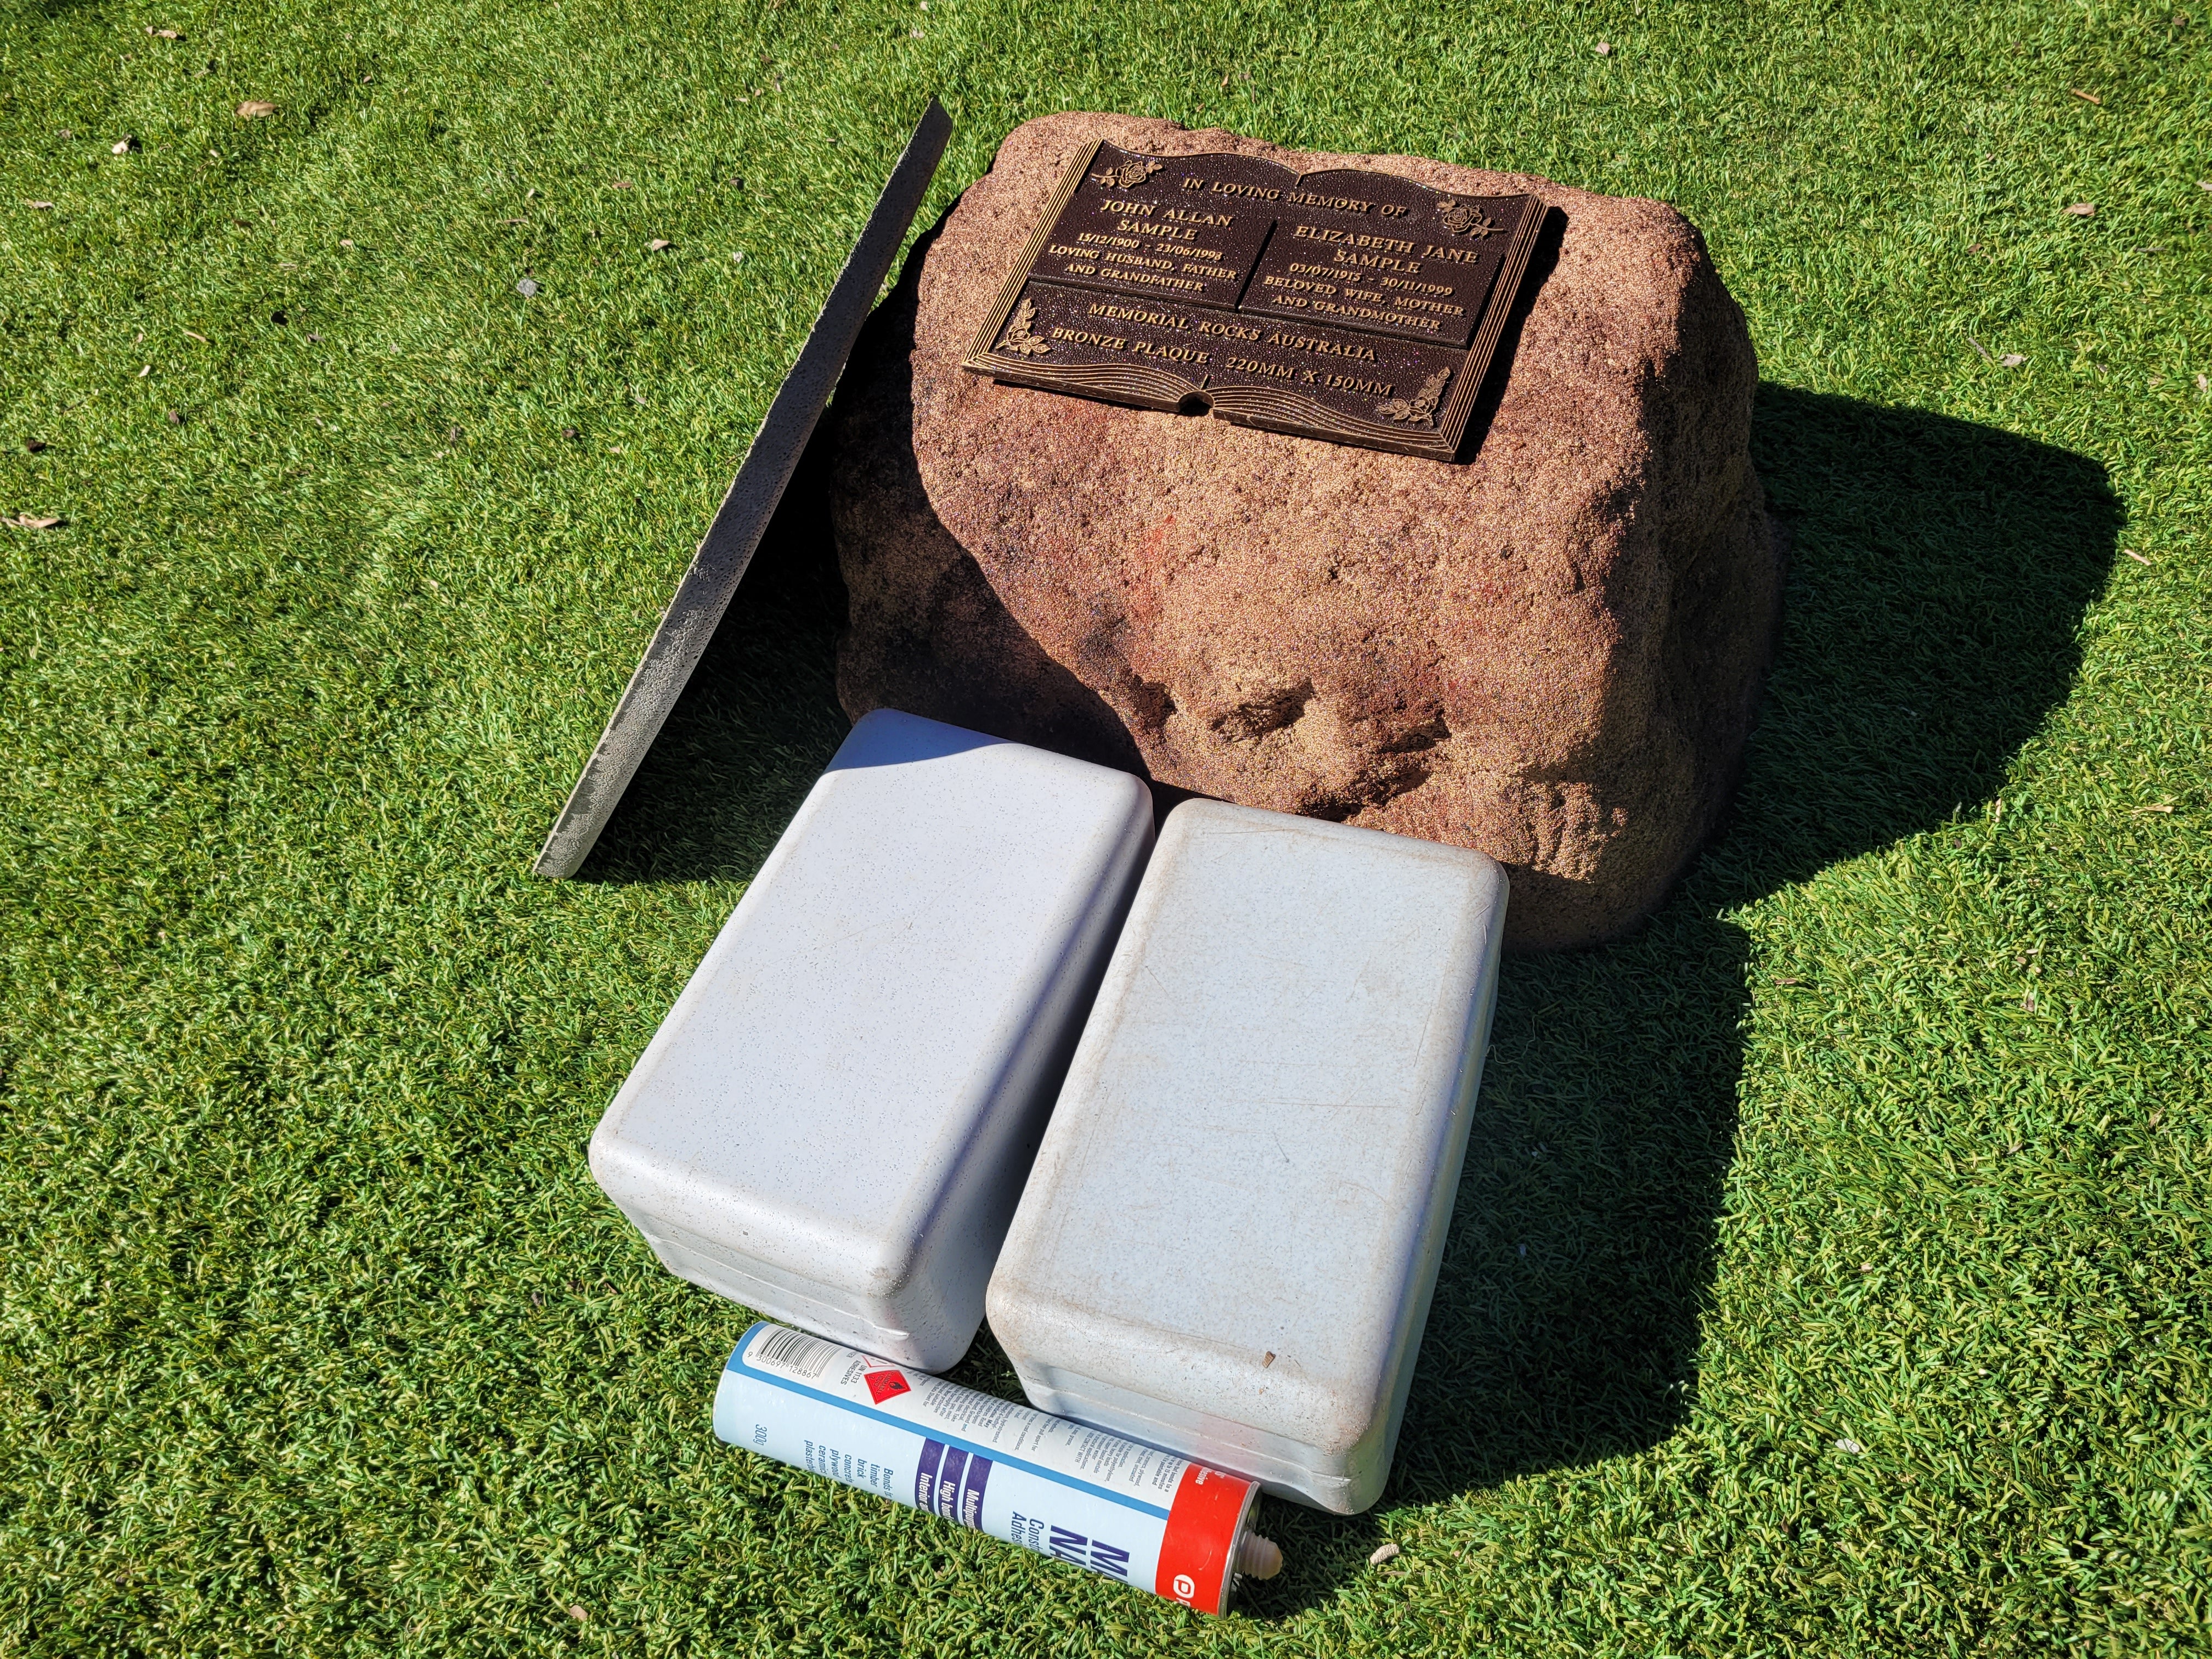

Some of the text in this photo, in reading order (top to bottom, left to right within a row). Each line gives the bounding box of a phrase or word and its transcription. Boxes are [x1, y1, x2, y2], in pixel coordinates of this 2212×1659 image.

[1183, 178, 1408, 217] IN LOVING MEMORY OF
[1101, 200, 1234, 226] JOHN ALLAN
[1118, 220, 1198, 241] SAMPLE
[1077, 233, 1139, 249] 15/12/1900
[1155, 244, 1222, 261] 23/06/1998
[1293, 225, 1480, 263] ELIZABETH JANE
[1049, 245, 1237, 279] LOVING HUSBAND, FATHER
[1334, 250, 1421, 274] SAMPLE
[1065, 264, 1203, 292] AND GRANDFATHER
[1290, 263, 1361, 282] 03/07/1915
[1380, 276, 1452, 296] 30/11/1999
[1264, 276, 1464, 317] BELOVED WIFE, MOTHER
[1272, 295, 1441, 330] AND GRANDMOTHER
[1088, 304, 1378, 362] MEMORIAL ROCKS AUSTRALIA
[1051, 327, 1394, 397] BRONZE PLAQUE 220MM X 150MM
[757, 1355, 786, 1369] 300697
[789, 1365, 816, 1379] 128867
[840, 1359, 861, 1385] ADHESIVES
[850, 1372, 861, 1383] 1133
[875, 1372, 894, 1396] FLAMMABLE
[925, 1392, 934, 1401] Sheet
[933, 1396, 945, 1413] protective
[939, 1407, 947, 1417] after
[951, 1413, 959, 1422] Take
[957, 1404, 970, 1421] electrical,
[964, 1410, 975, 1423] Ground
[977, 1417, 986, 1426] Read
[983, 1419, 992, 1428] May
[753, 1424, 768, 1446] 300g
[992, 1419, 1008, 1443] hydrotreated
[1014, 1431, 1026, 1451] conditions.
[1079, 1437, 1090, 1452] CONTACT
[830, 1448, 841, 1478] plywood
[1074, 1451, 1084, 1463] WITH
[1079, 1447, 1092, 1470] applications.
[1093, 1459, 1102, 1474] metals
[1103, 1457, 1112, 1466] loads
[857, 1459, 867, 1479] brick
[870, 1463, 880, 1487] timber
[883, 1468, 894, 1491] Bonds
[1104, 1457, 1119, 1482] polyethylene,
[1128, 1464, 1138, 1482] uncoated
[1133, 1469, 1145, 1487] plywood,
[1158, 1472, 1167, 1489] minutes
[1167, 1471, 1176, 1483] bonds
[918, 1472, 933, 1503] Interior
[940, 1480, 955, 1503] High
